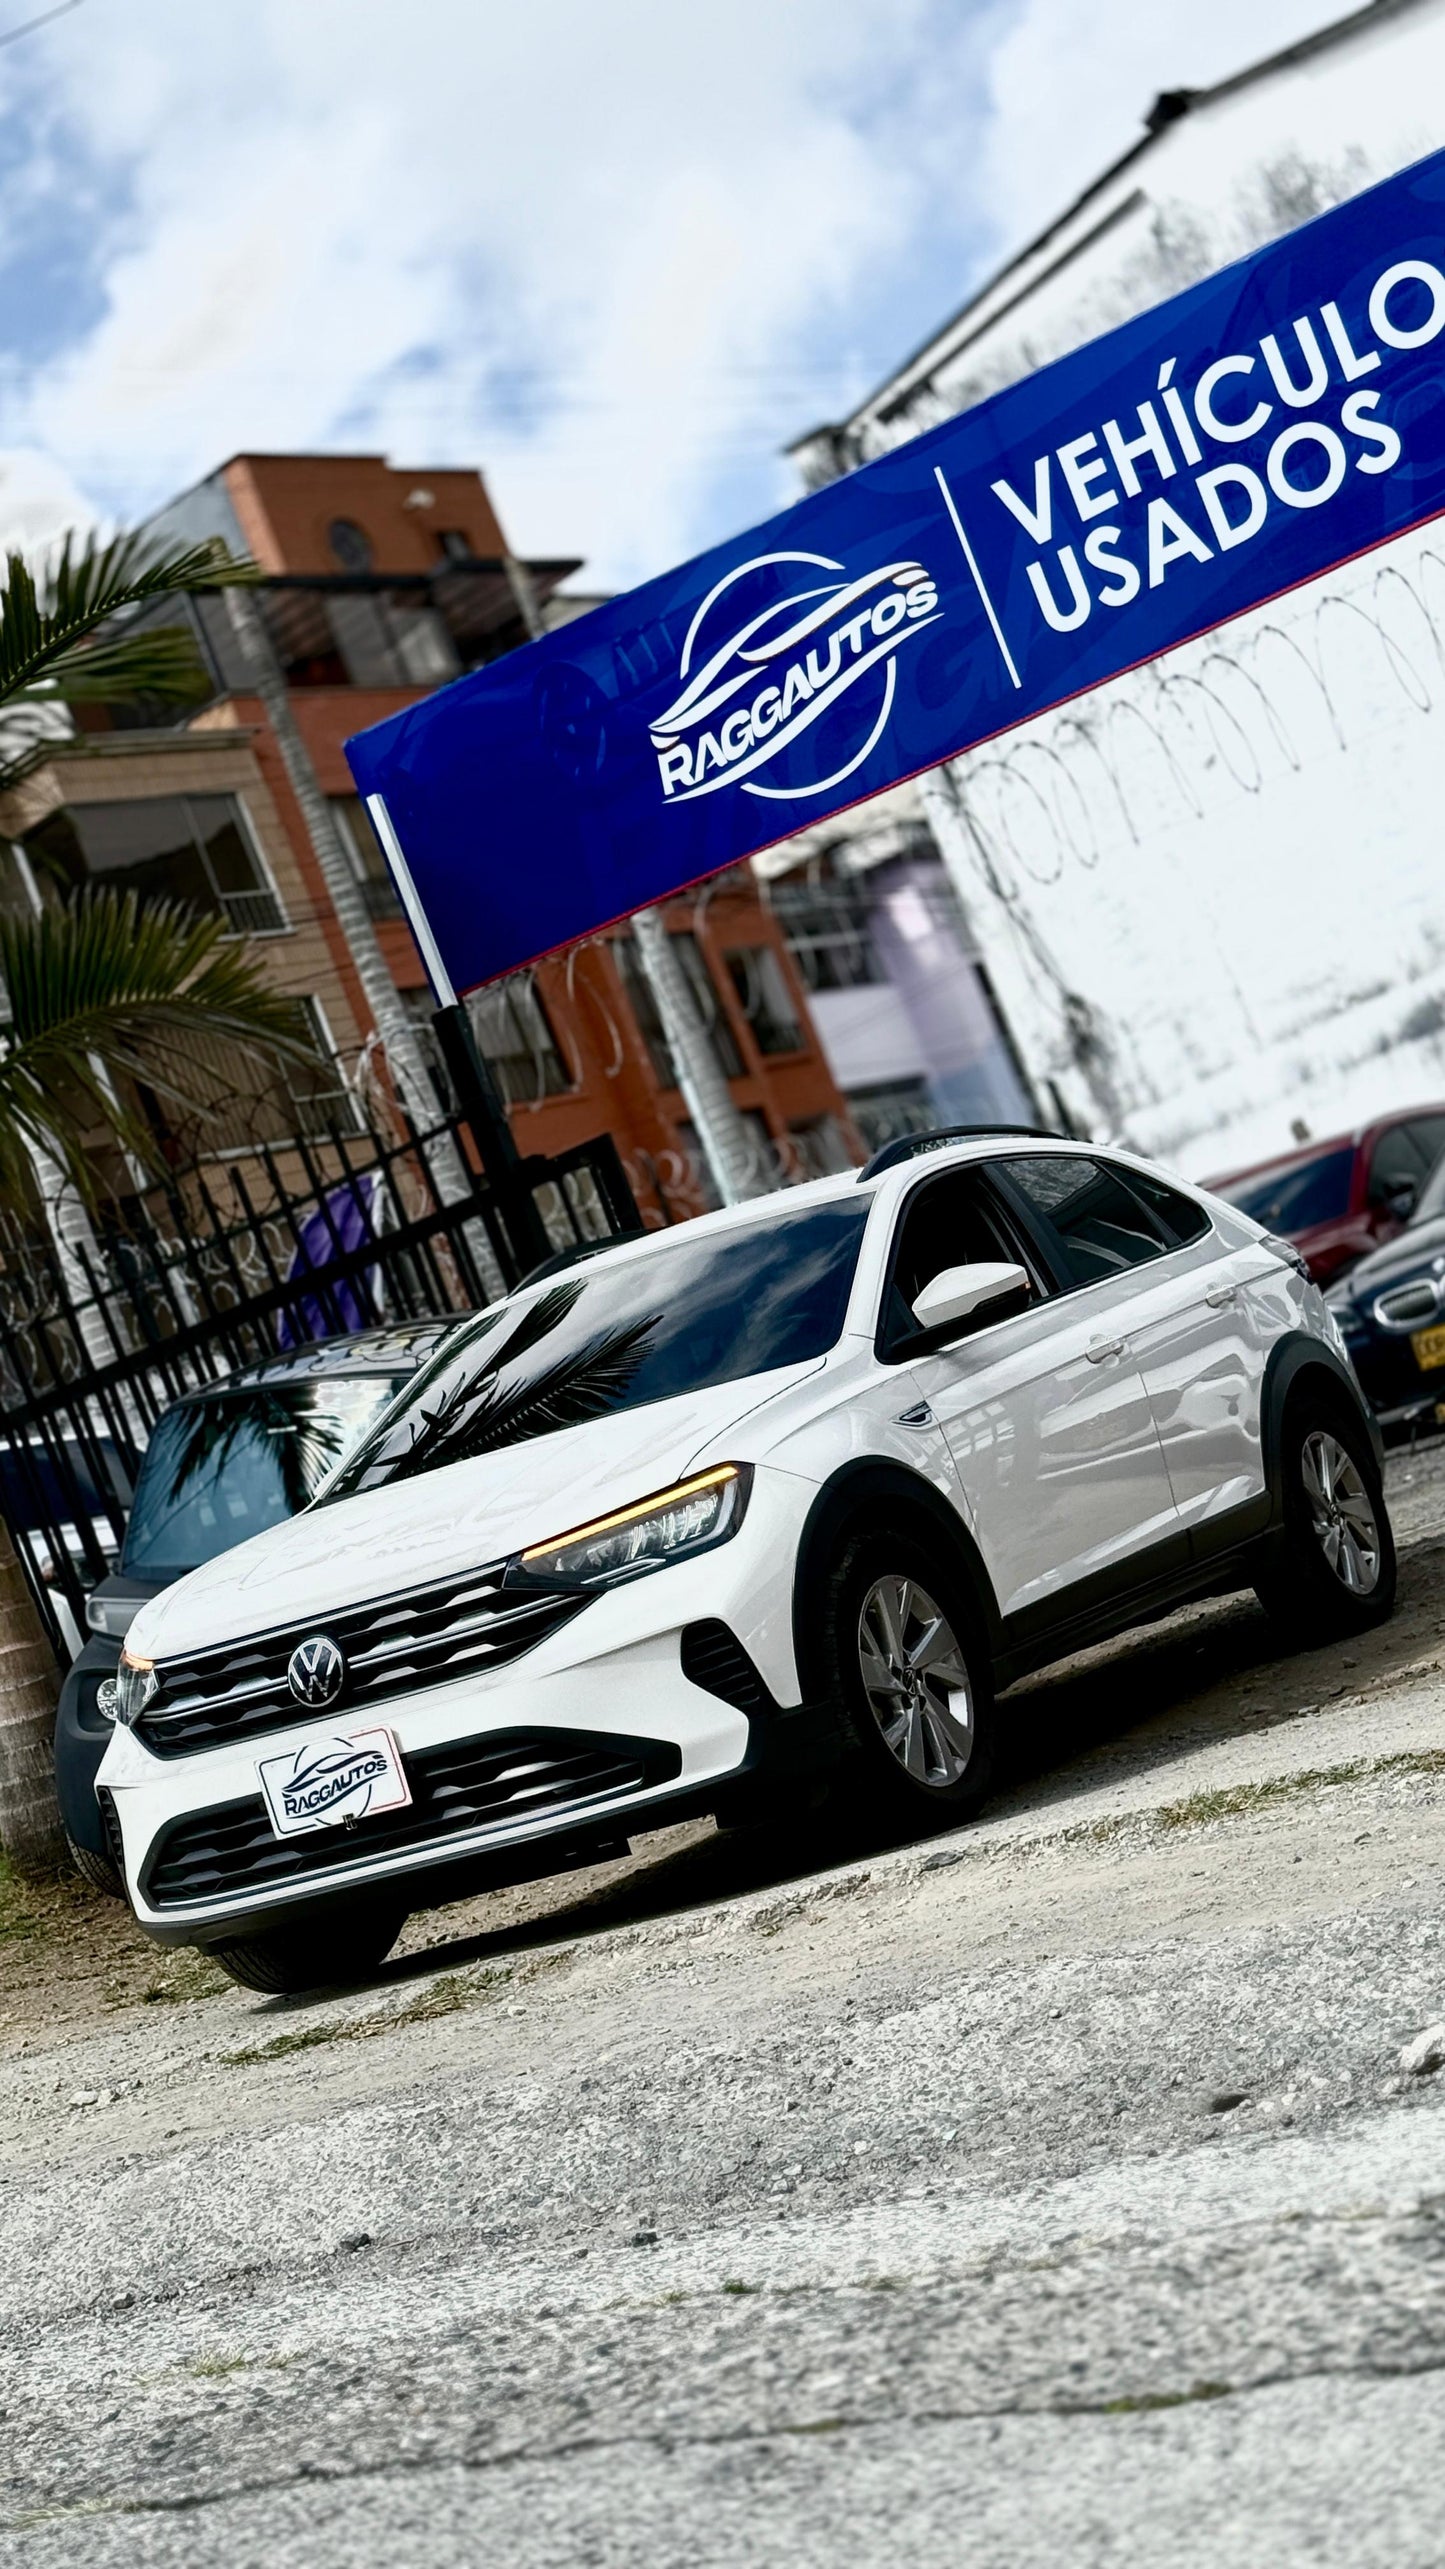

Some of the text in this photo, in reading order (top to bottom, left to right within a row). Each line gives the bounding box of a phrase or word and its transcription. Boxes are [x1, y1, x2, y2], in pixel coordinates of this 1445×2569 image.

[991, 260, 1445, 545] VEHÍCULO
[1026, 390, 1401, 633] USADOS
[657, 581, 938, 796] RAGGAUTOS
[284, 1759, 388, 1816] RAGGAUTOS
